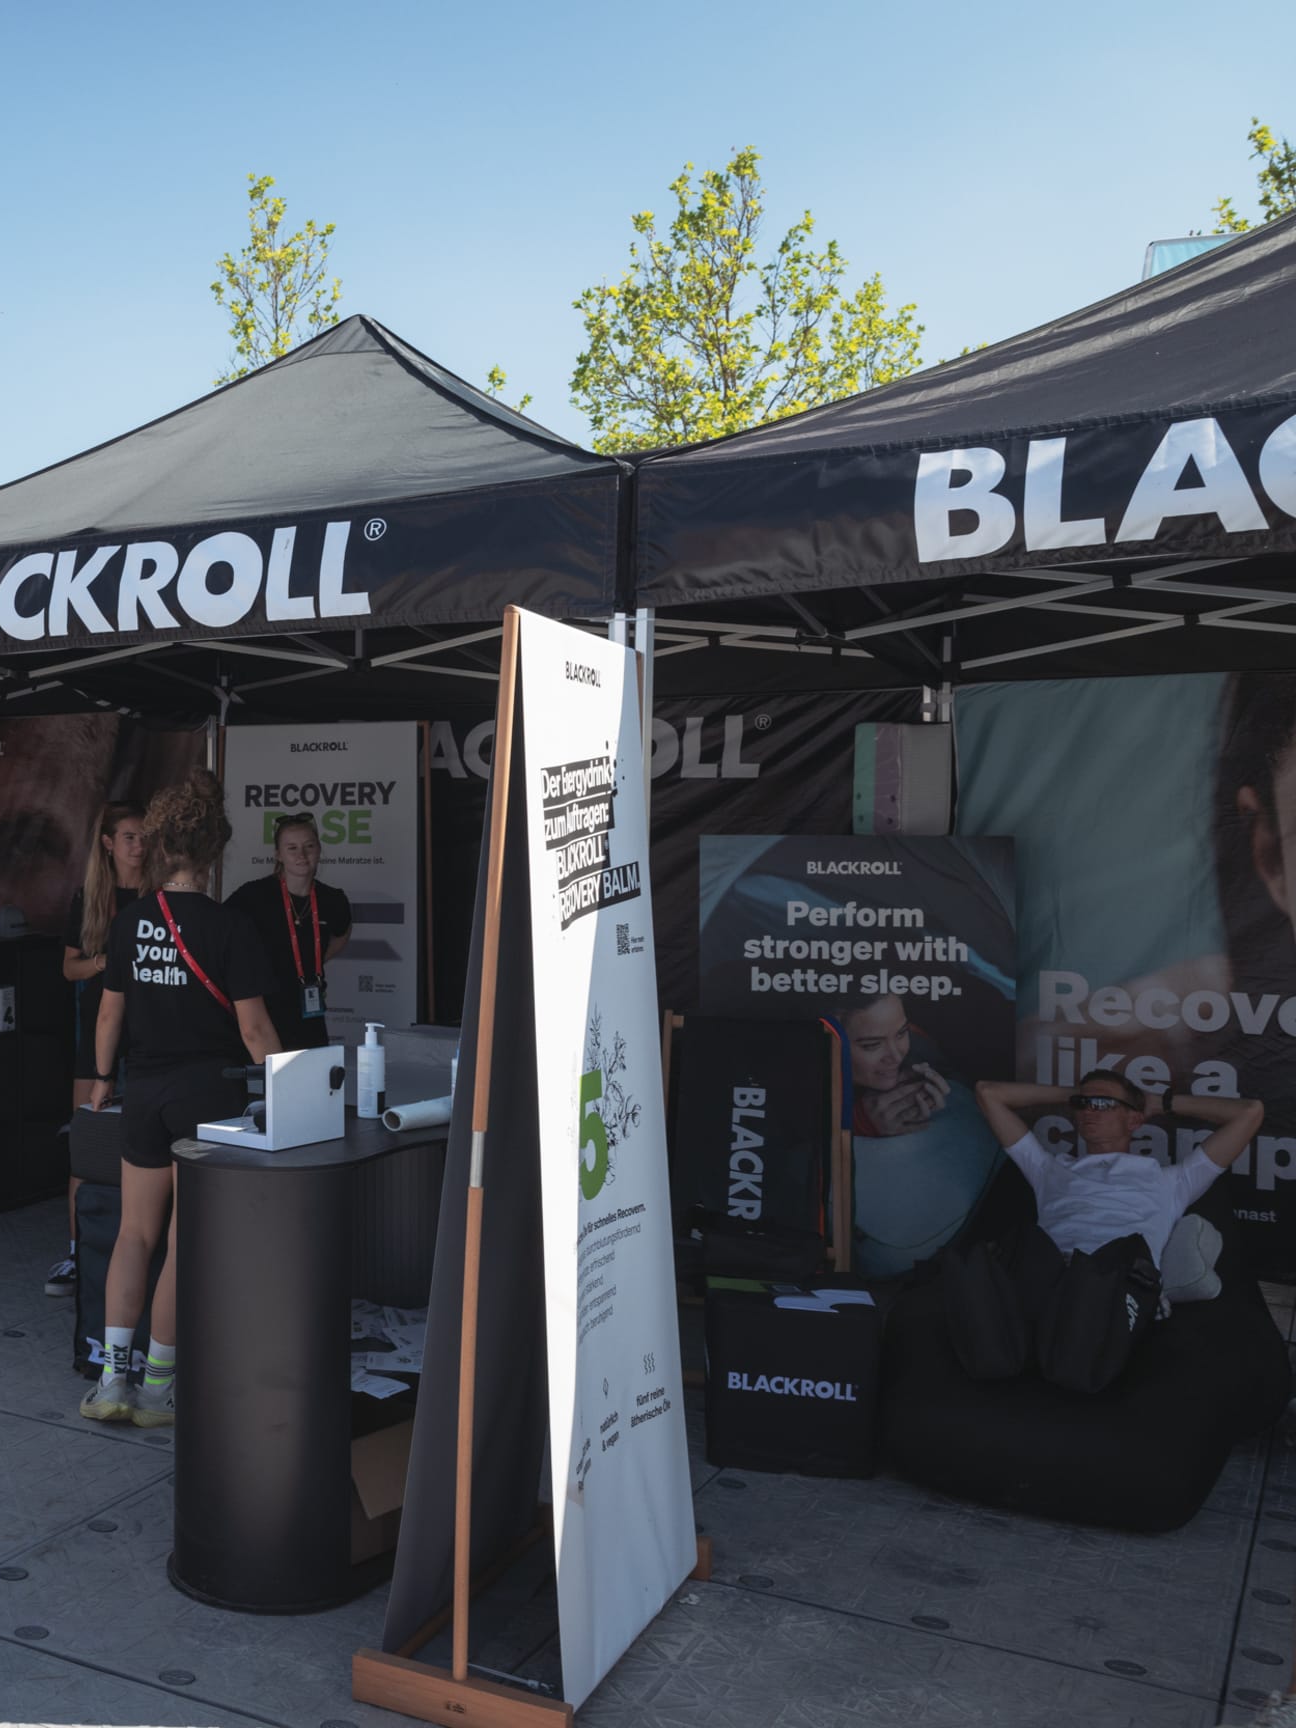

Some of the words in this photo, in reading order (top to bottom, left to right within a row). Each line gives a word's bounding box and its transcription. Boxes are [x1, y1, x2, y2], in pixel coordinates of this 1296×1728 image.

[565, 661, 601, 688] BLACKROLL
[290, 742, 349, 752] BLACKROLL
[245, 781, 396, 807] RECOVERY
[263, 809, 372, 846] SE
[807, 861, 902, 876] BLACKROLL
[786, 901, 925, 929] Perform
[136, 919, 167, 942] Do
[743, 935, 888, 966] stronger
[894, 935, 968, 962] with
[750, 966, 854, 993] better
[860, 969, 962, 1001] sleep.
[1190, 1059, 1241, 1099] a
[579, 1069, 608, 1200] 5
[726, 1371, 856, 1402] BLACKROLL
